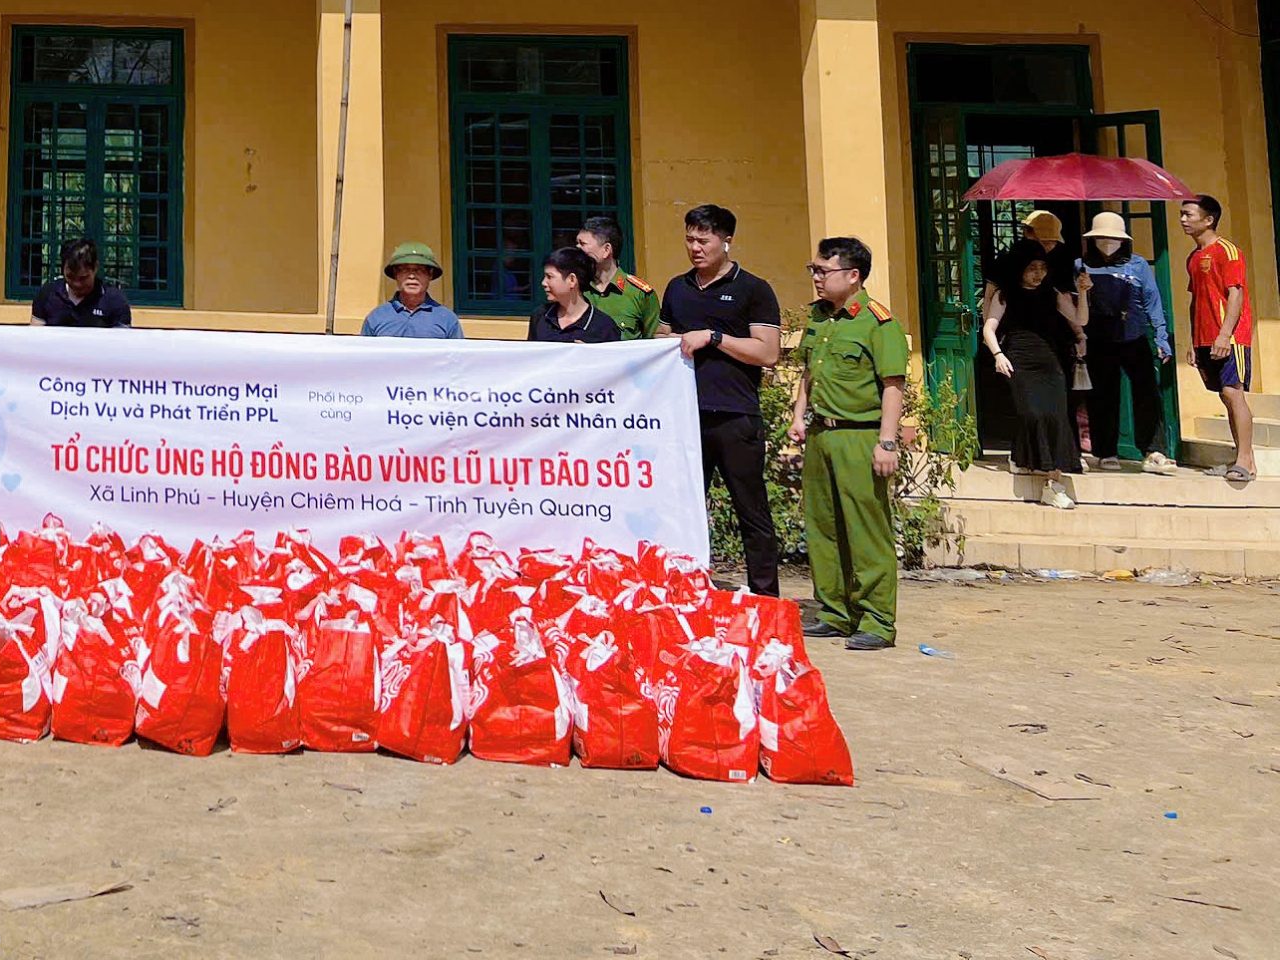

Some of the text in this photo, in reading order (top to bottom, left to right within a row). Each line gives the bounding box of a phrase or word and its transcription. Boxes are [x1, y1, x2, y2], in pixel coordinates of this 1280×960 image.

[39, 376, 278, 402] Công TY TNHH Thương Mại
[308, 390, 364, 407] Phối hợp
[386, 386, 615, 407] Viện Khoa học Cảnh sát
[50, 400, 279, 423] Dịch Vụ và Phát Triển PPL
[320, 408, 352, 422] cùng
[387, 409, 661, 431] Học viện Cảnh sát Nhân dân
[51, 432, 653, 492] TỔ CHỨC ỦNG HỘ ĐỒNG BÀO VÙNG LŨ LỤT BÃO SỐ 3
[89, 484, 115, 502] Xã
[120, 486, 158, 504] Linh
[165, 487, 200, 506] Phú
[223, 490, 285, 512] Huyện
[290, 491, 355, 510] Chiêm
[361, 494, 402, 512] Hoá
[425, 495, 467, 514] Tỉnh
[473, 496, 533, 519] Tuyên
[539, 498, 612, 522] Quang
